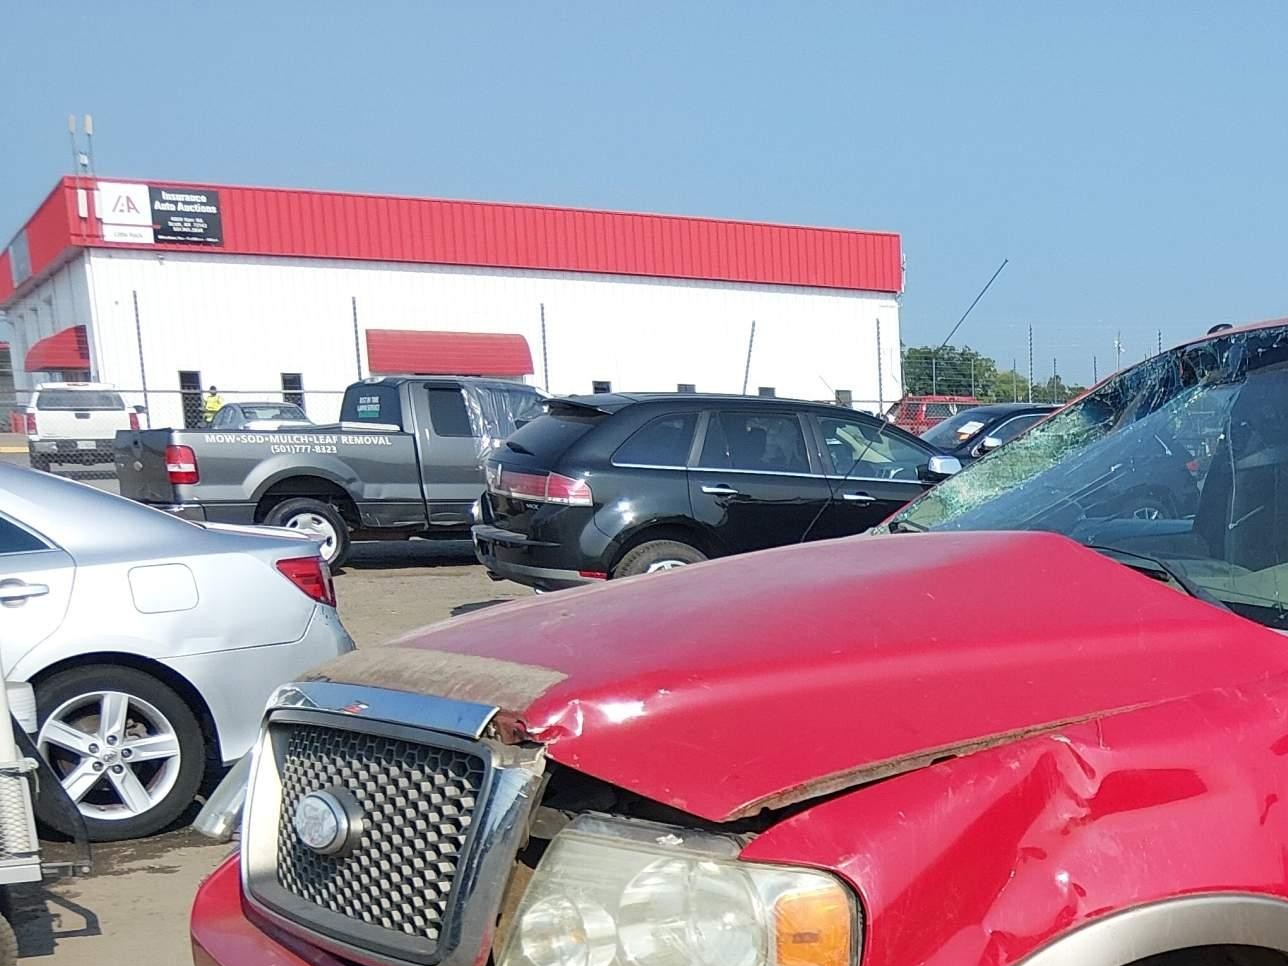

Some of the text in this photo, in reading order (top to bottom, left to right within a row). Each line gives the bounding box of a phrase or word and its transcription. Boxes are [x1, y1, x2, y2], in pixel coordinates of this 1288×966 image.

[161, 191, 207, 203] Insurance
[154, 201, 217, 214] Auto Auctions
[341, 435, 392, 445] REMOVAL
[271, 445, 337, 454] (501)777-8323
